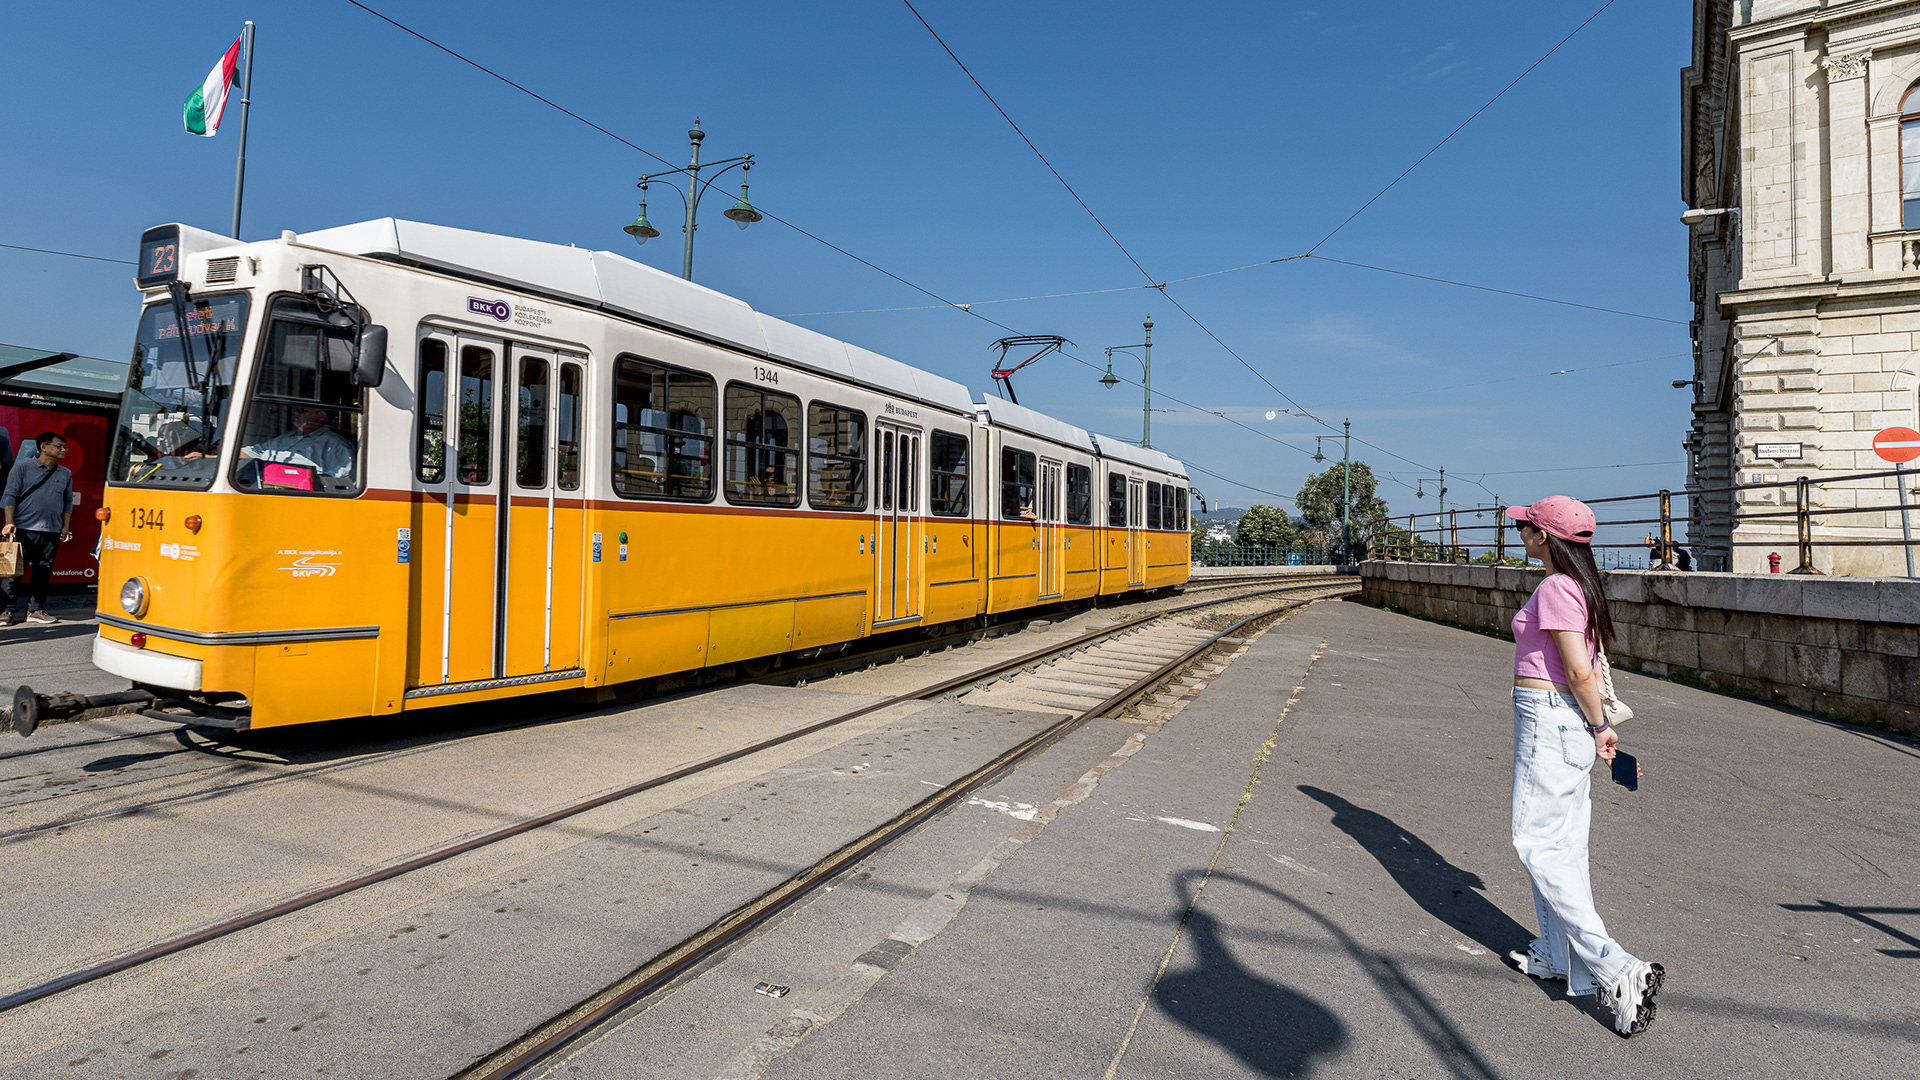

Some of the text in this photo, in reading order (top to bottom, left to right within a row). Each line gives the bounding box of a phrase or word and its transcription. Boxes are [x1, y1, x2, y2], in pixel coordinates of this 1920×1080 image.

[153, 244, 175, 273] 23
[473, 302, 493, 313] BKK
[515, 305, 546, 316] BUDAPESTI
[754, 366, 778, 384] 1344
[896, 407, 918, 418] BUDAPEST
[131, 508, 164, 531] 1344
